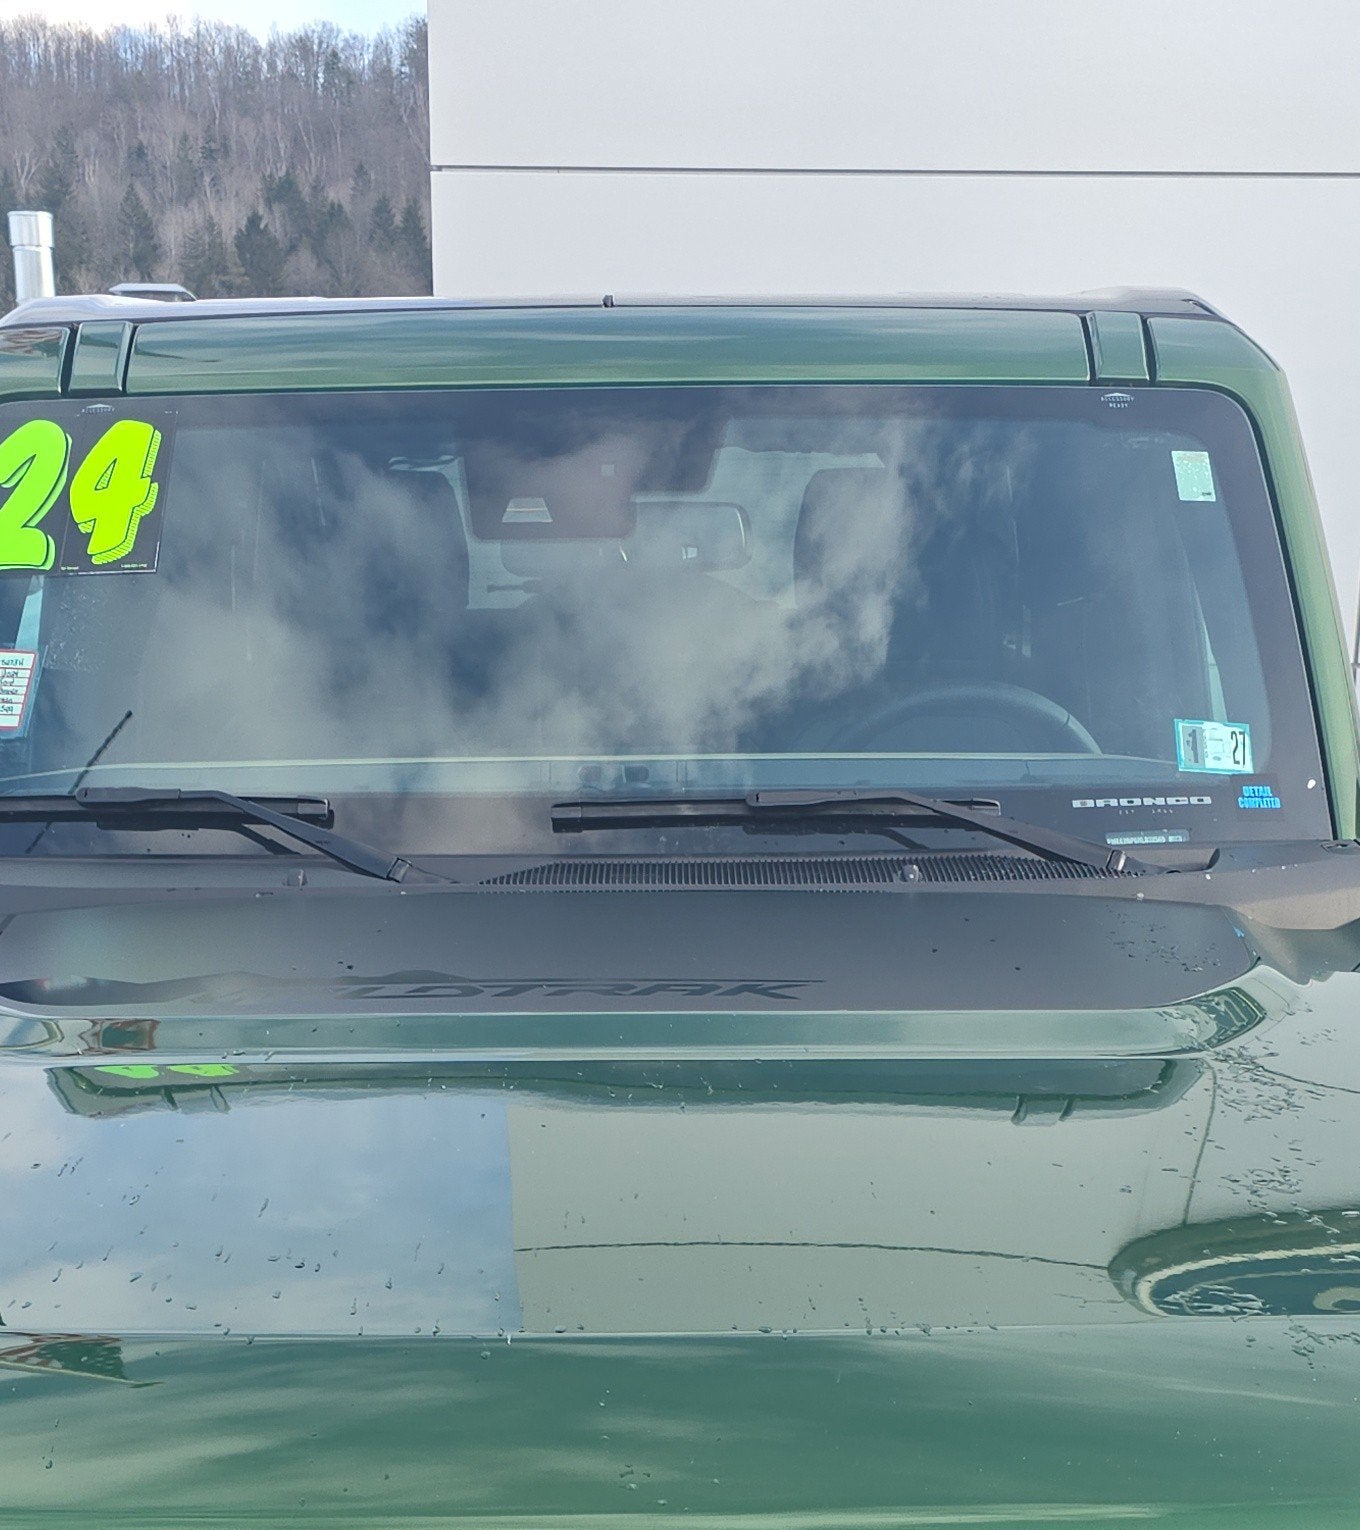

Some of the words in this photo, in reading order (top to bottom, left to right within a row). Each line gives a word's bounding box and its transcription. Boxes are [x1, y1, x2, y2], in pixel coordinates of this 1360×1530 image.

[1230, 730, 1247, 767] 27
[1242, 785, 1273, 798] DETAIL
[1072, 796, 1212, 808] BRONCO
[1237, 797, 1281, 809] COMPLETED
